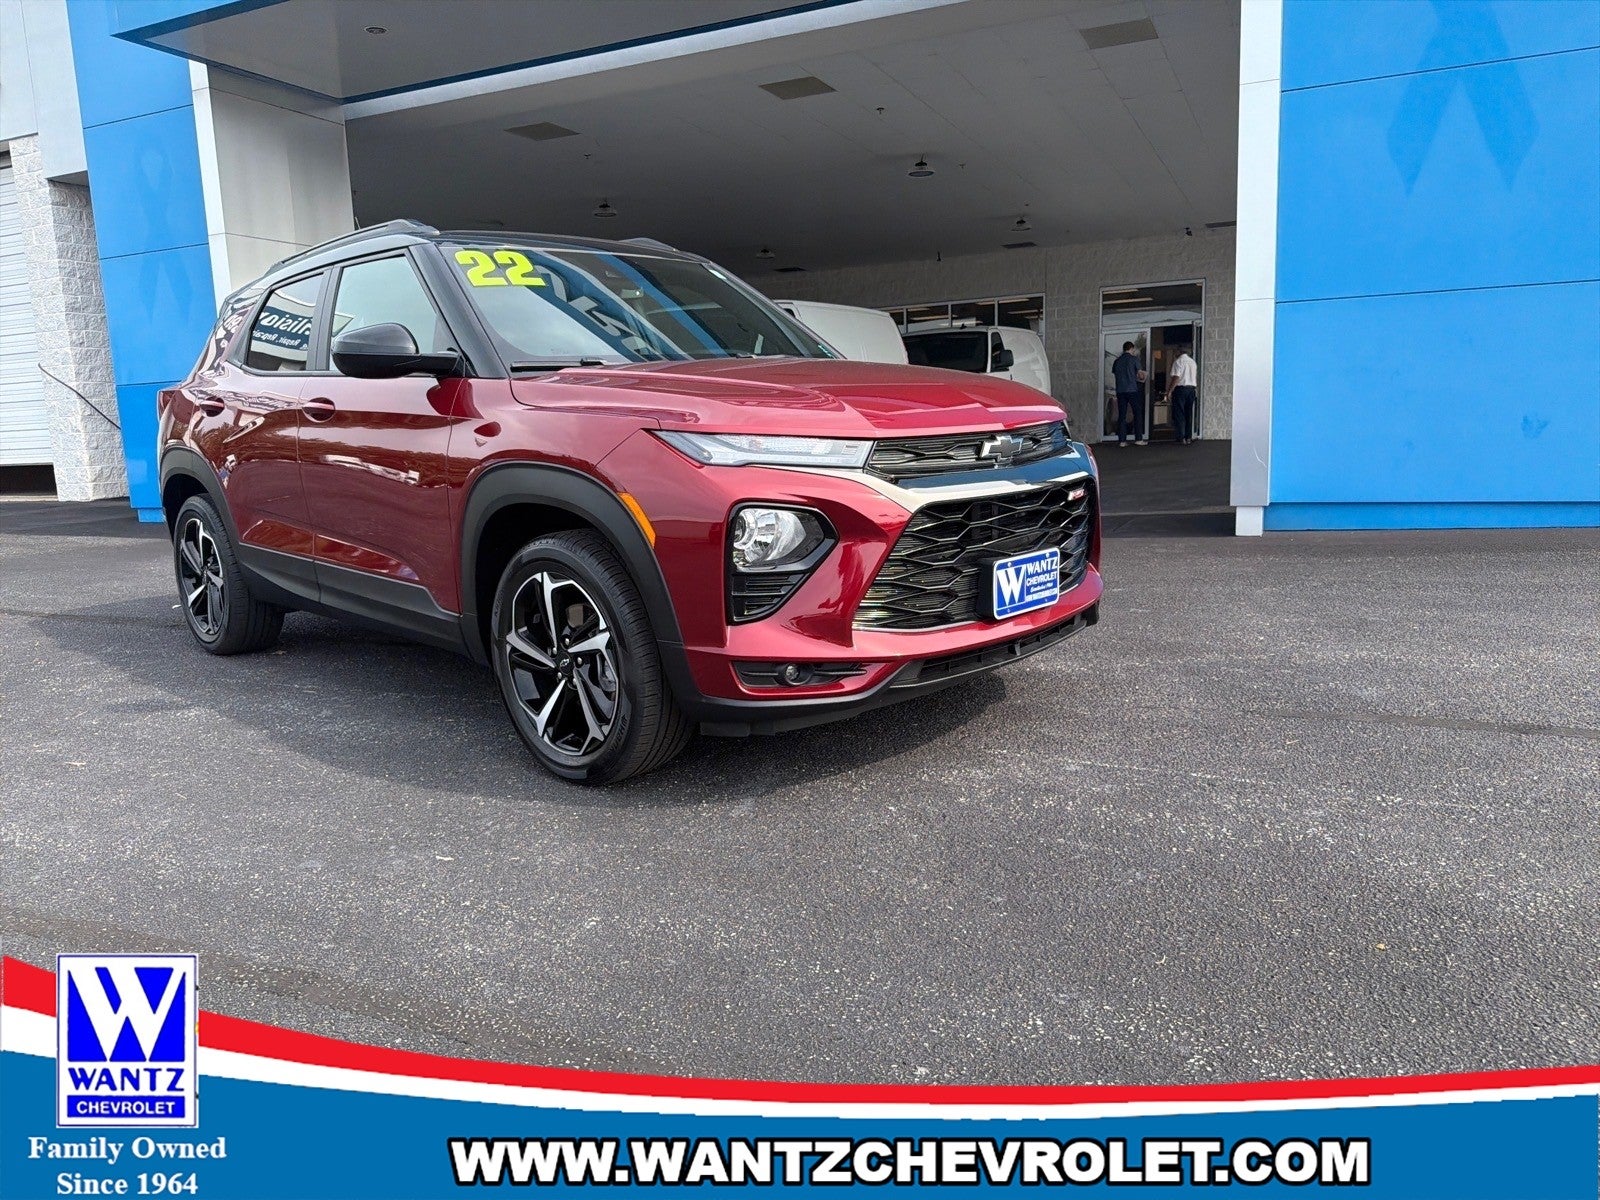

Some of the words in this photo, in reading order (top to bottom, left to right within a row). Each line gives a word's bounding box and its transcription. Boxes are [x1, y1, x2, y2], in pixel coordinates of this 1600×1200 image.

[454, 250, 546, 287] 22
[1026, 556, 1058, 576] WANTZ
[1026, 571, 1058, 587] CHEVROLET
